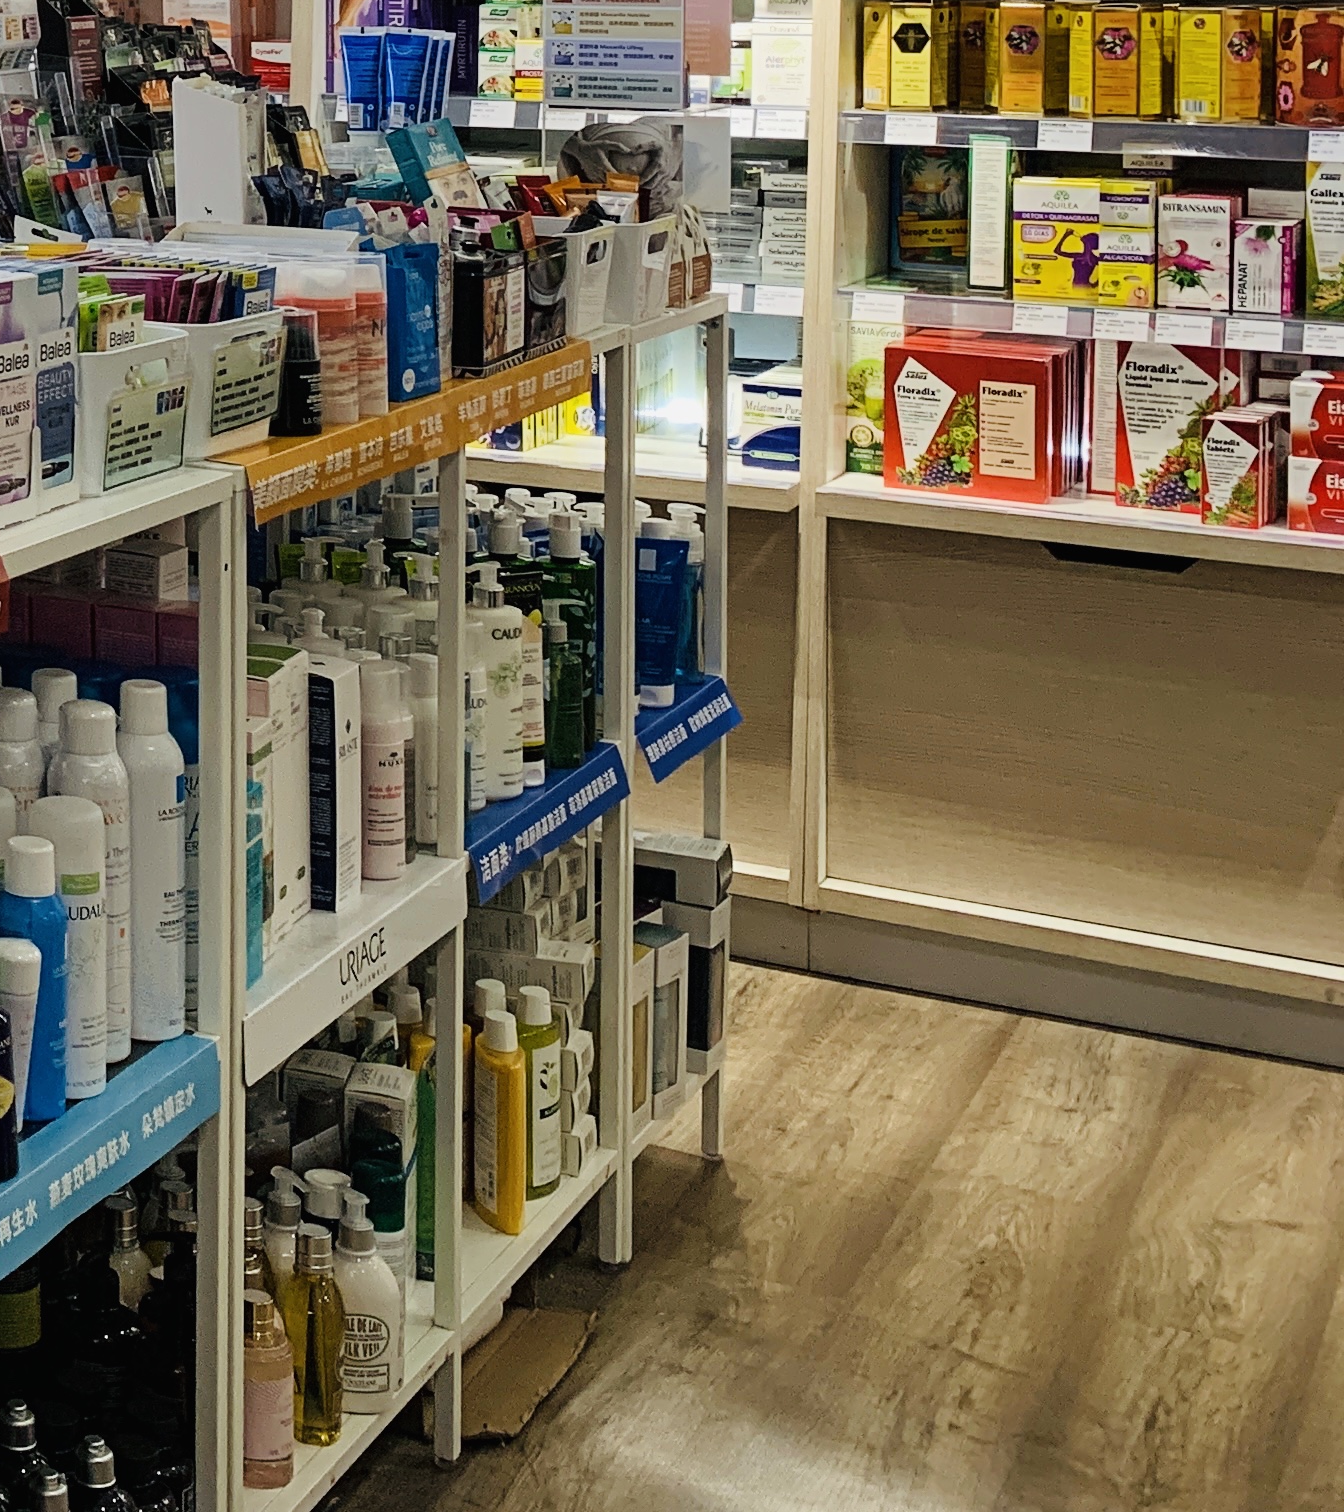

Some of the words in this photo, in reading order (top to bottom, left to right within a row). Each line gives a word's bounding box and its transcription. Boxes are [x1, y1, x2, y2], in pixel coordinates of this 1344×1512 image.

[1041, 200, 1080, 211] AQUILEA
[1163, 202, 1228, 216] BITRANSAMIN
[1237, 260, 1248, 309] HEPANAT
[109, 329, 136, 348] Balea
[40, 340, 71, 363] Balea
[38, 368, 73, 388] BEAUTY
[37, 383, 73, 405] EFFECT
[338, 927, 387, 987] URIAGE
